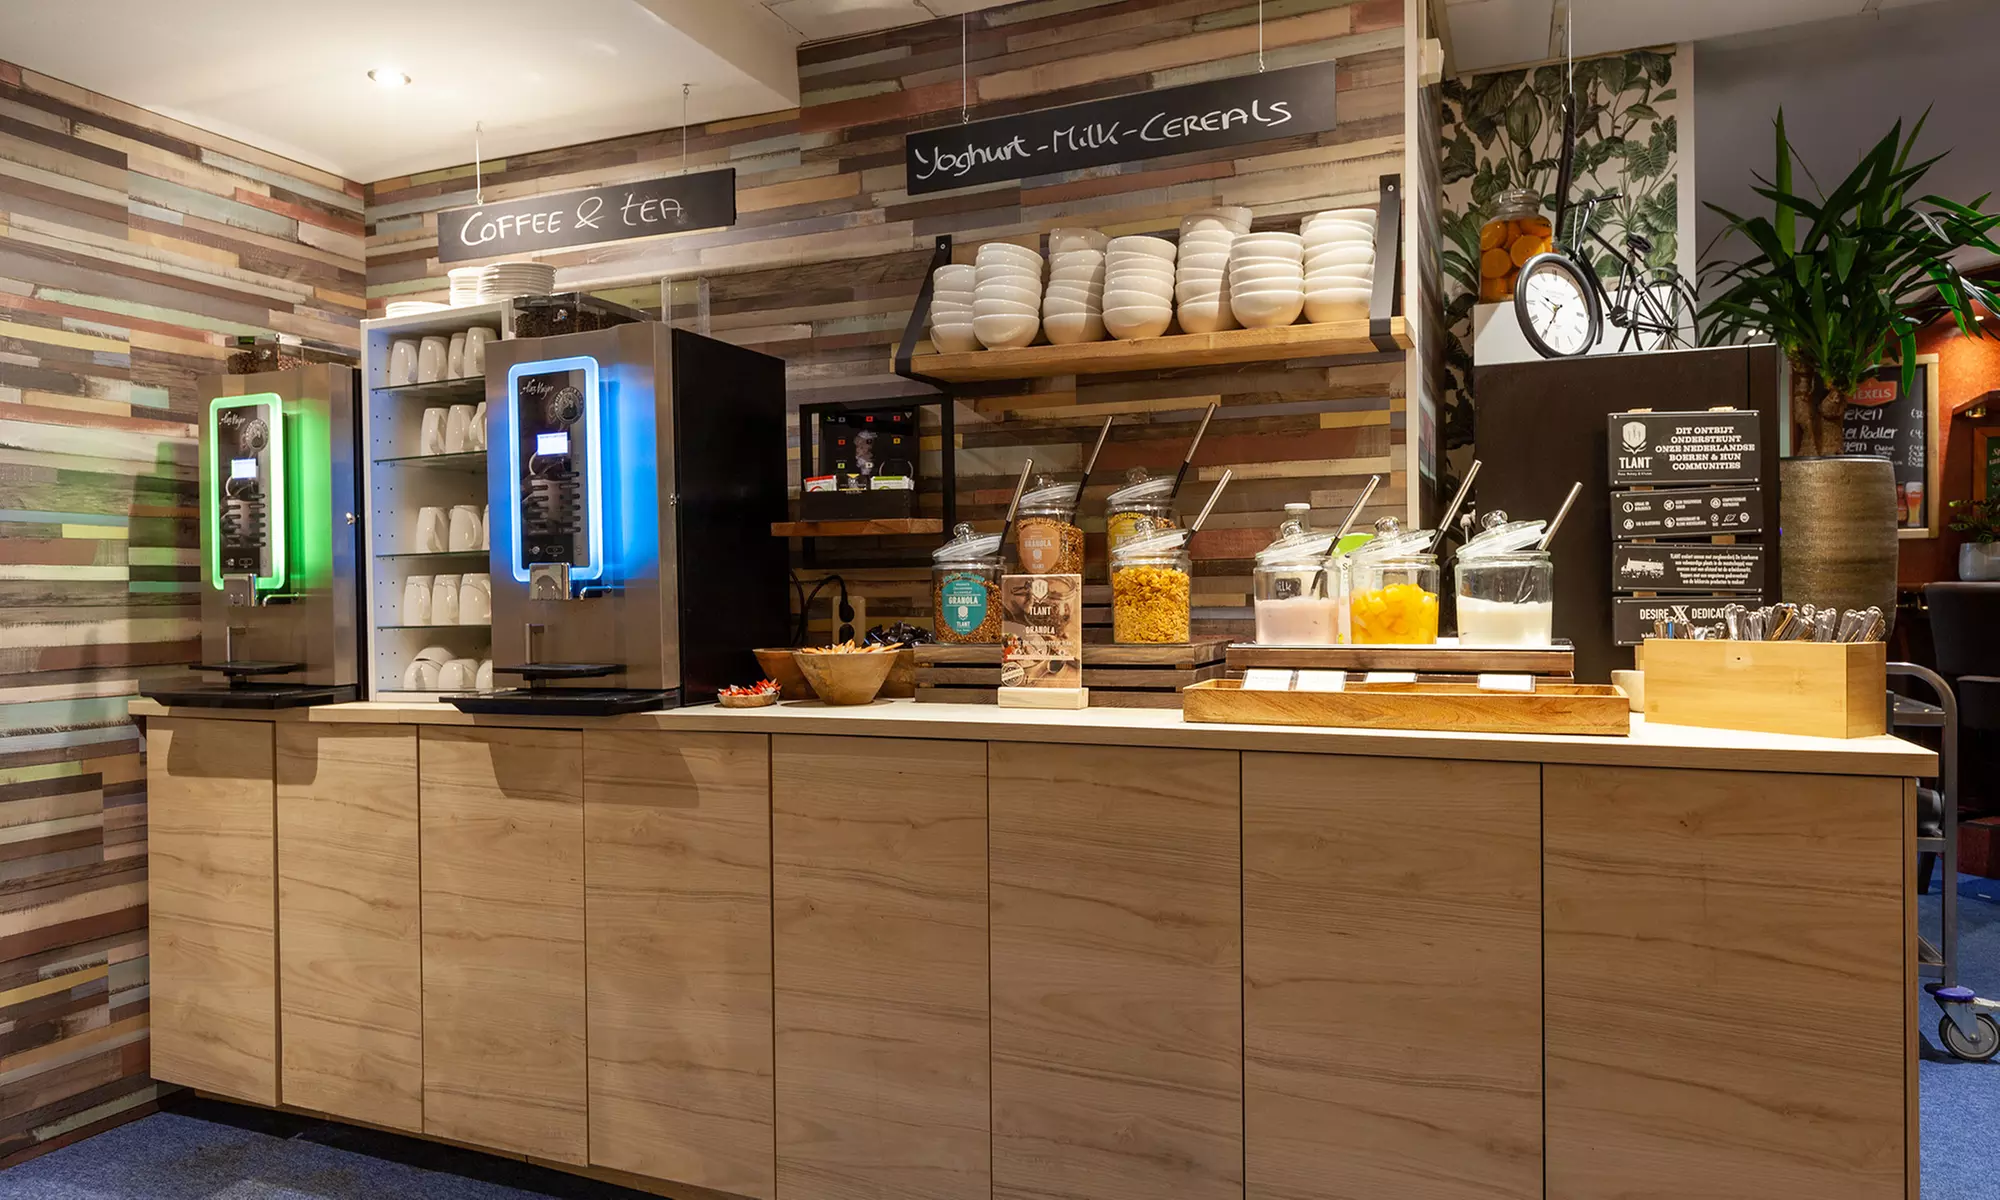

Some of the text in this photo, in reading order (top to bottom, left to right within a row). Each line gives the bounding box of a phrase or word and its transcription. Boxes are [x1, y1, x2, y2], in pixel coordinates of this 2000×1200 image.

[460, 211, 563, 246] COFFEE
[574, 196, 605, 229] &
[1844, 408, 1883, 421] eken
[1694, 426, 1734, 434] ONTBIJT
[1670, 435, 1742, 444] ONDERSTEUNT
[1655, 444, 1755, 453] ONZE NEDERLANDSE
[1669, 453, 1709, 461] BOEREN
[1619, 457, 1651, 469] TLANT
[1672, 462, 1741, 470] COMMUNITIES
[948, 596, 979, 605] GRANOLA
[1029, 606, 1051, 616] TLANT
[1640, 608, 1669, 620] DESIRE
[1691, 608, 1726, 619] DEDICAT
[1025, 626, 1055, 635] GRANOLA
